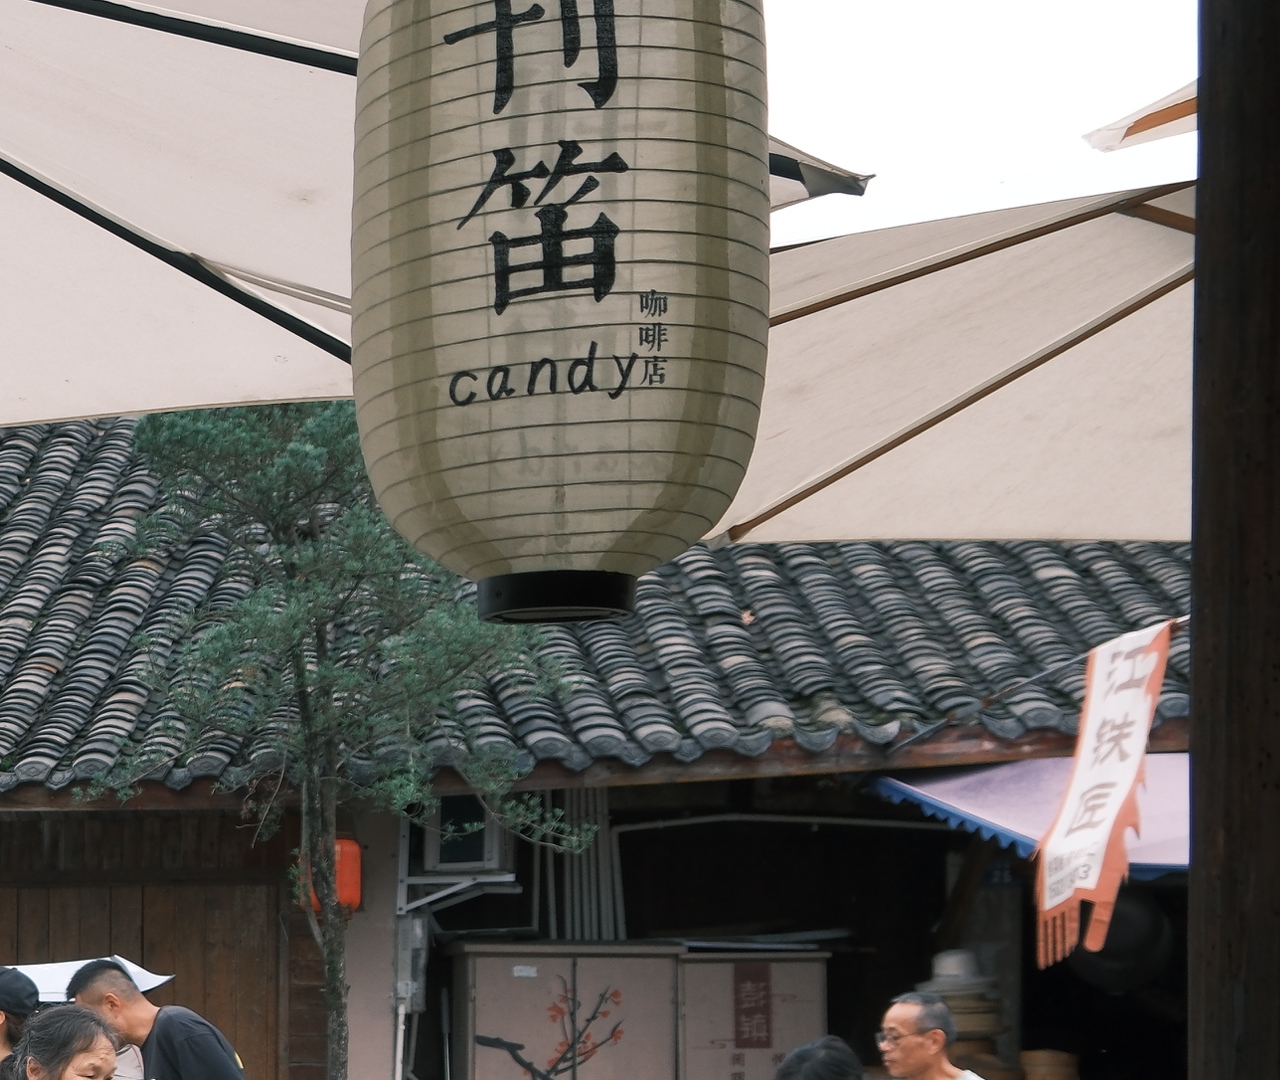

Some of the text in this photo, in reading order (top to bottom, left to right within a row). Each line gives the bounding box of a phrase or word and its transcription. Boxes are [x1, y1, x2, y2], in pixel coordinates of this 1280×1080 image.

[448, 341, 637, 406] candy
[638, 289, 668, 386] 咖啡店
